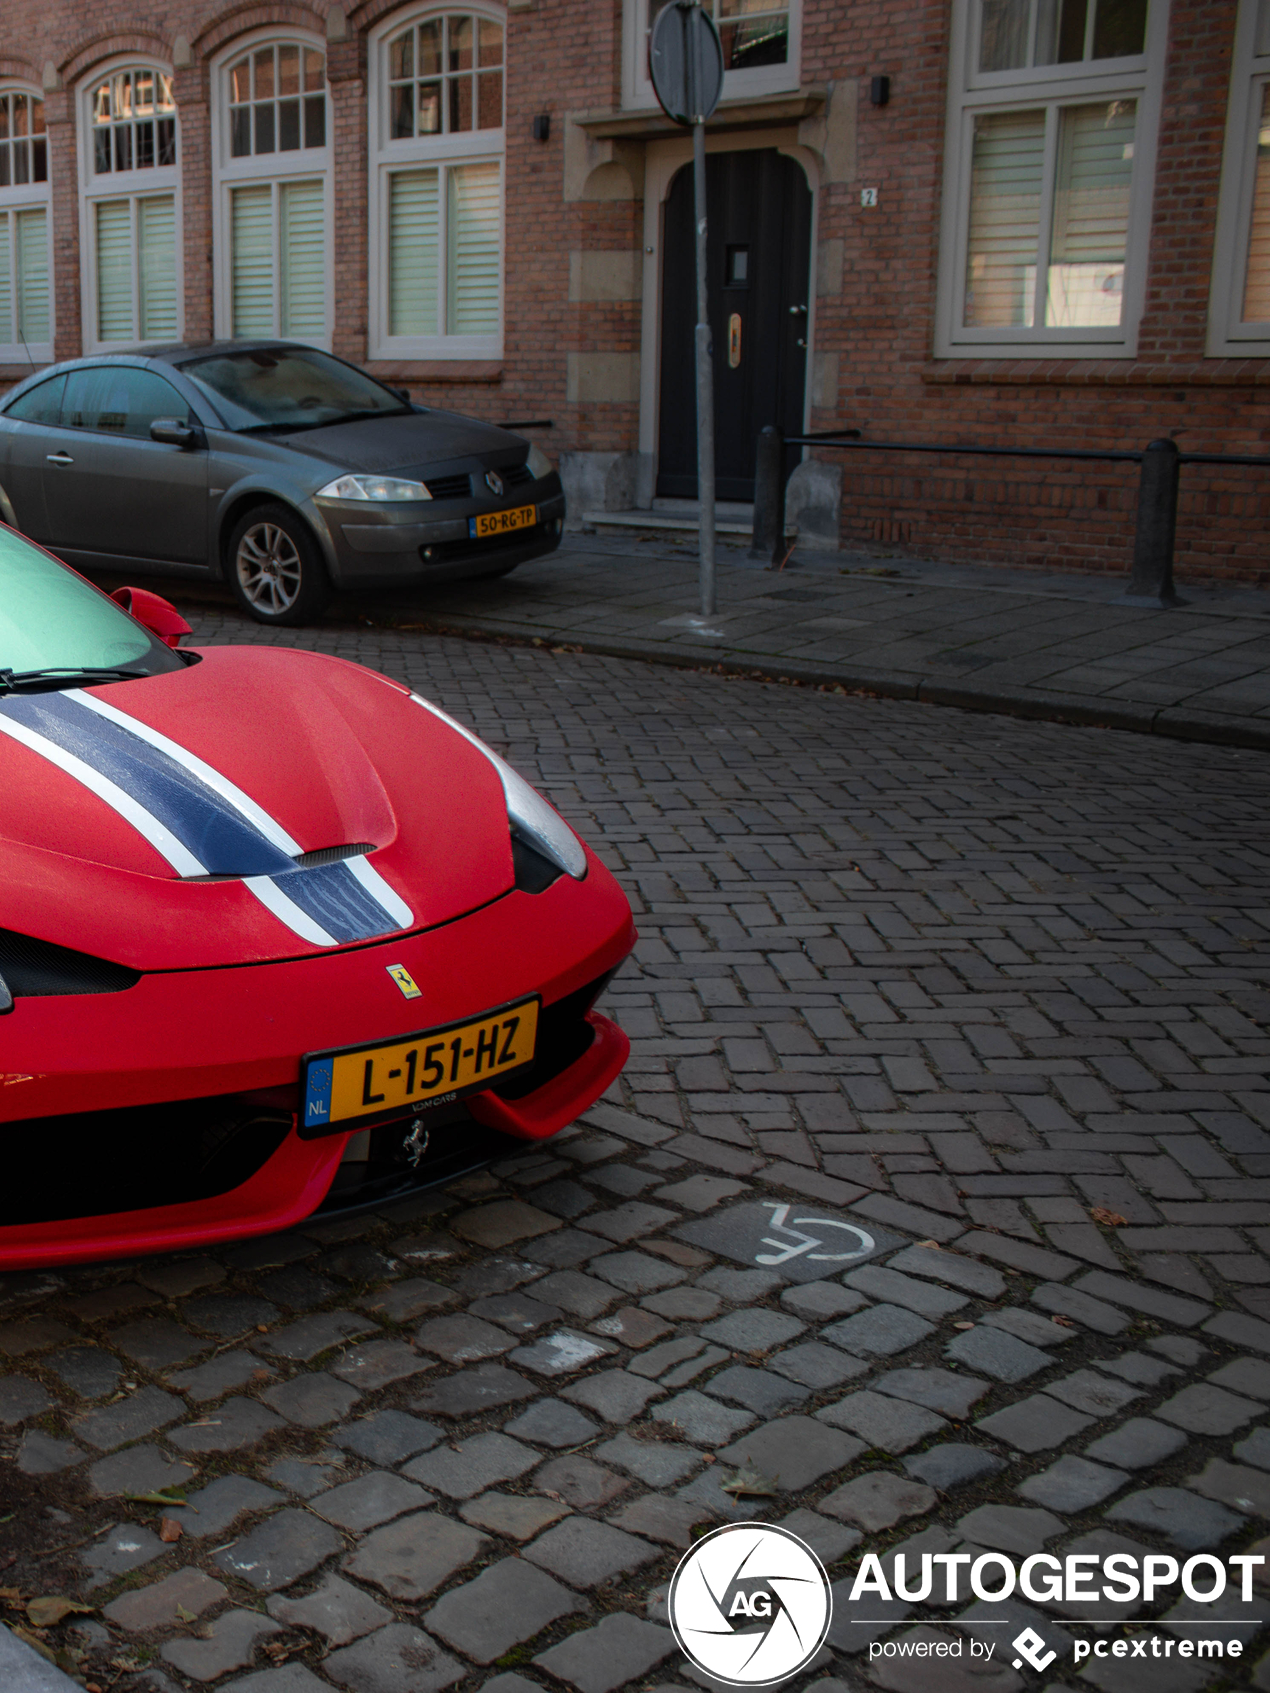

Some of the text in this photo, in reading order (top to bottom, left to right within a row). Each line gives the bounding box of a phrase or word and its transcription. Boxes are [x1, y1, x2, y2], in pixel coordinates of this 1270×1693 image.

[866, 189, 874, 205] 2
[480, 507, 533, 533] 50-RG-TP
[362, 1016, 520, 1106] L-151-HZ
[308, 1099, 328, 1117] NL
[432, 1091, 458, 1107] CARS
